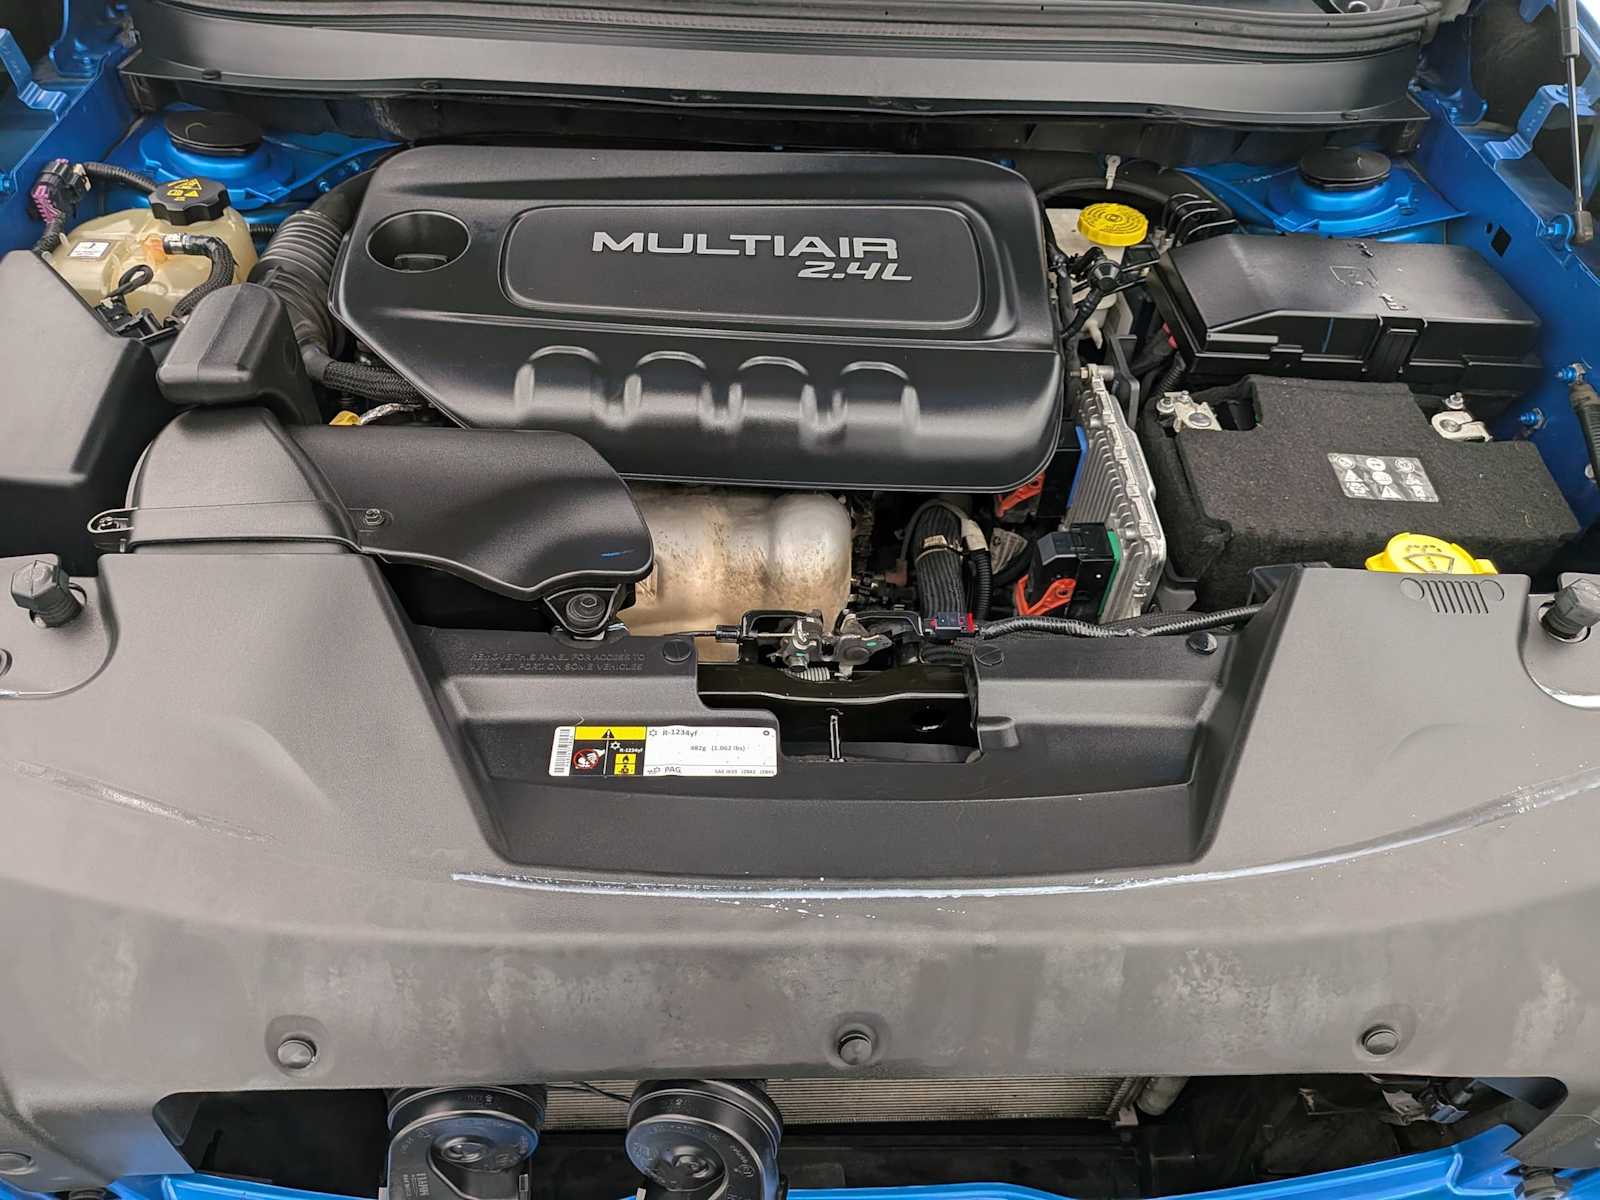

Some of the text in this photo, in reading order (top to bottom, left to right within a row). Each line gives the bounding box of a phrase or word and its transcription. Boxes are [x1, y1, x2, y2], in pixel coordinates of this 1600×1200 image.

[592, 231, 898, 259] MULTIAIR
[797, 260, 912, 281] 2.4L
[664, 766, 682, 774] PAG
